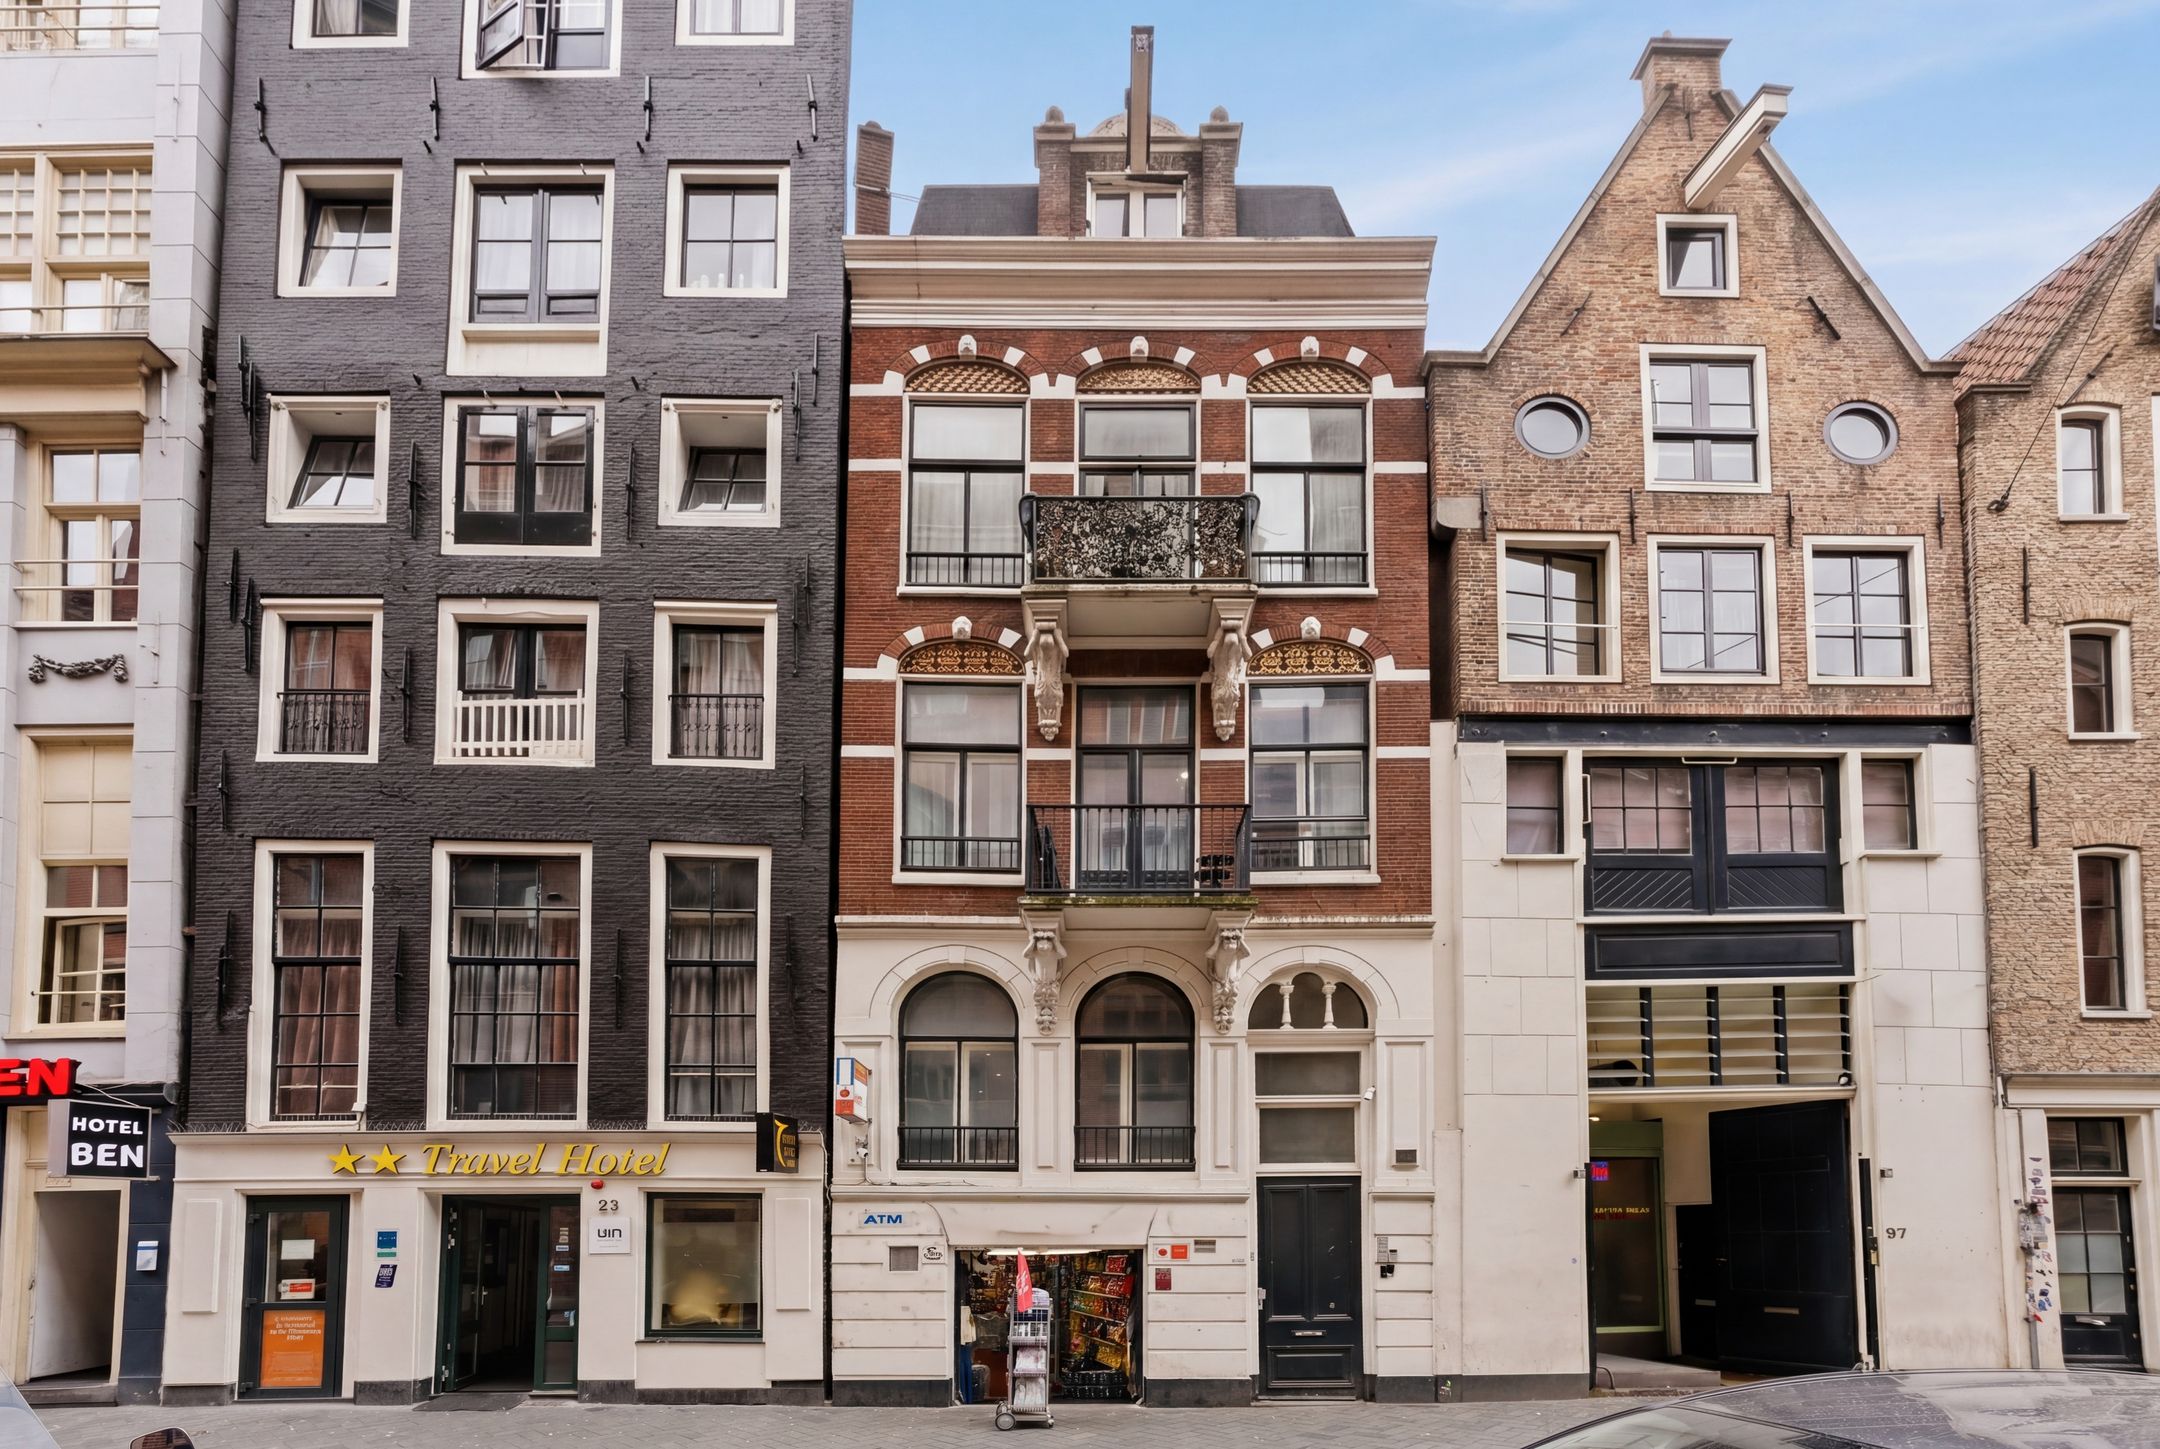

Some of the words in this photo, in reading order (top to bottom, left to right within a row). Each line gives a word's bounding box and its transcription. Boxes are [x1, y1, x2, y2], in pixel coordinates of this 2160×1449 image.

[72, 1116, 144, 1135] HOTEL
[71, 1142, 144, 1168] BEN
[422, 1142, 547, 1176] Travel
[556, 1142, 672, 1177] Hotel
[598, 1199, 619, 1212] 23
[863, 1214, 903, 1224] ATM
[1885, 1227, 1907, 1240] 97
